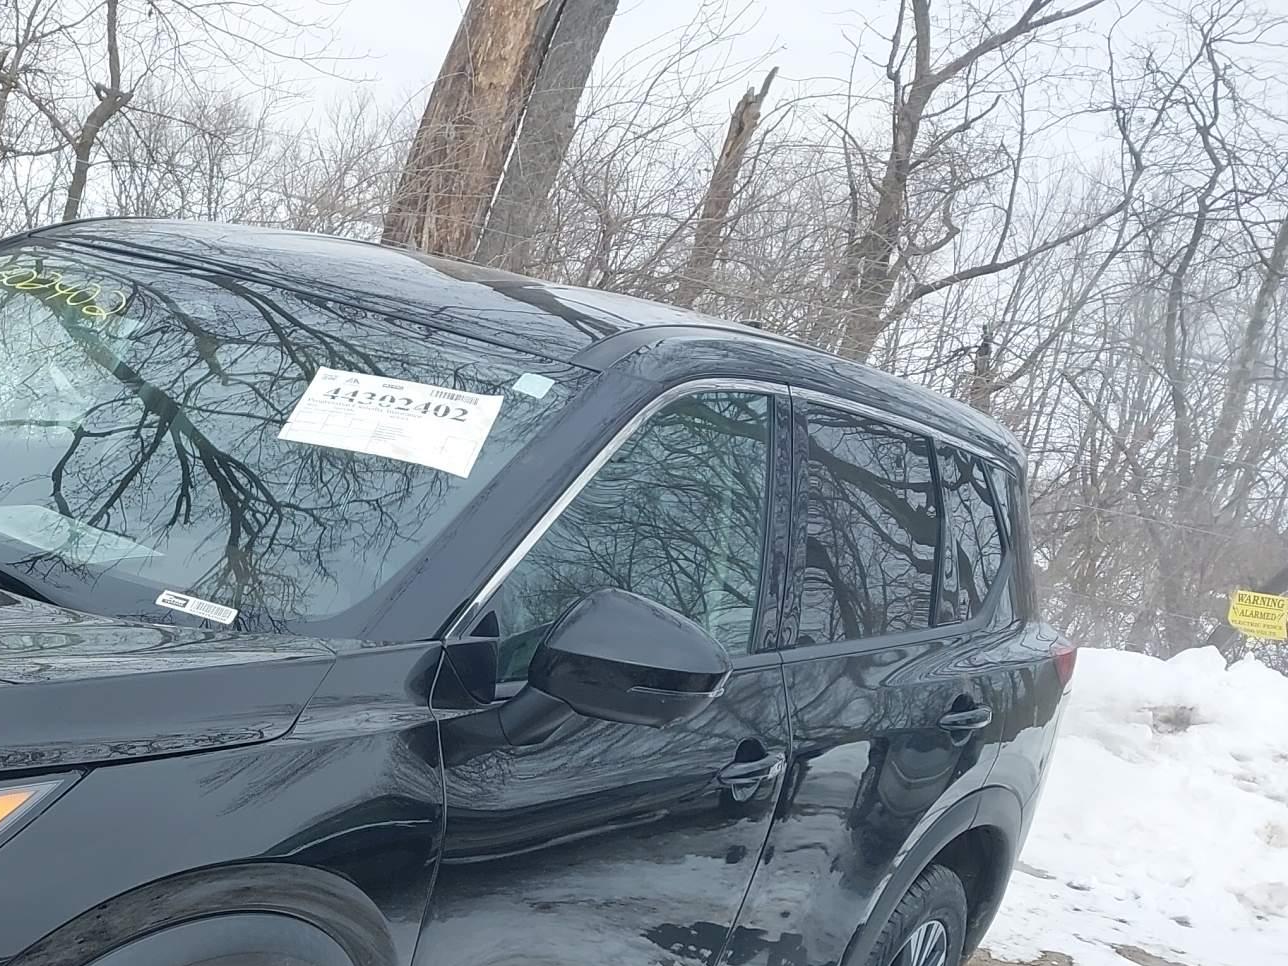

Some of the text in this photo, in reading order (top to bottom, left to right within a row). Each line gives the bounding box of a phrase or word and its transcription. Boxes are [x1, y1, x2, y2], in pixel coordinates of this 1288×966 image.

[322, 385, 470, 423] 44302402
[1238, 593, 1285, 609] WARNING
[1239, 609, 1278, 621] ALARMED
